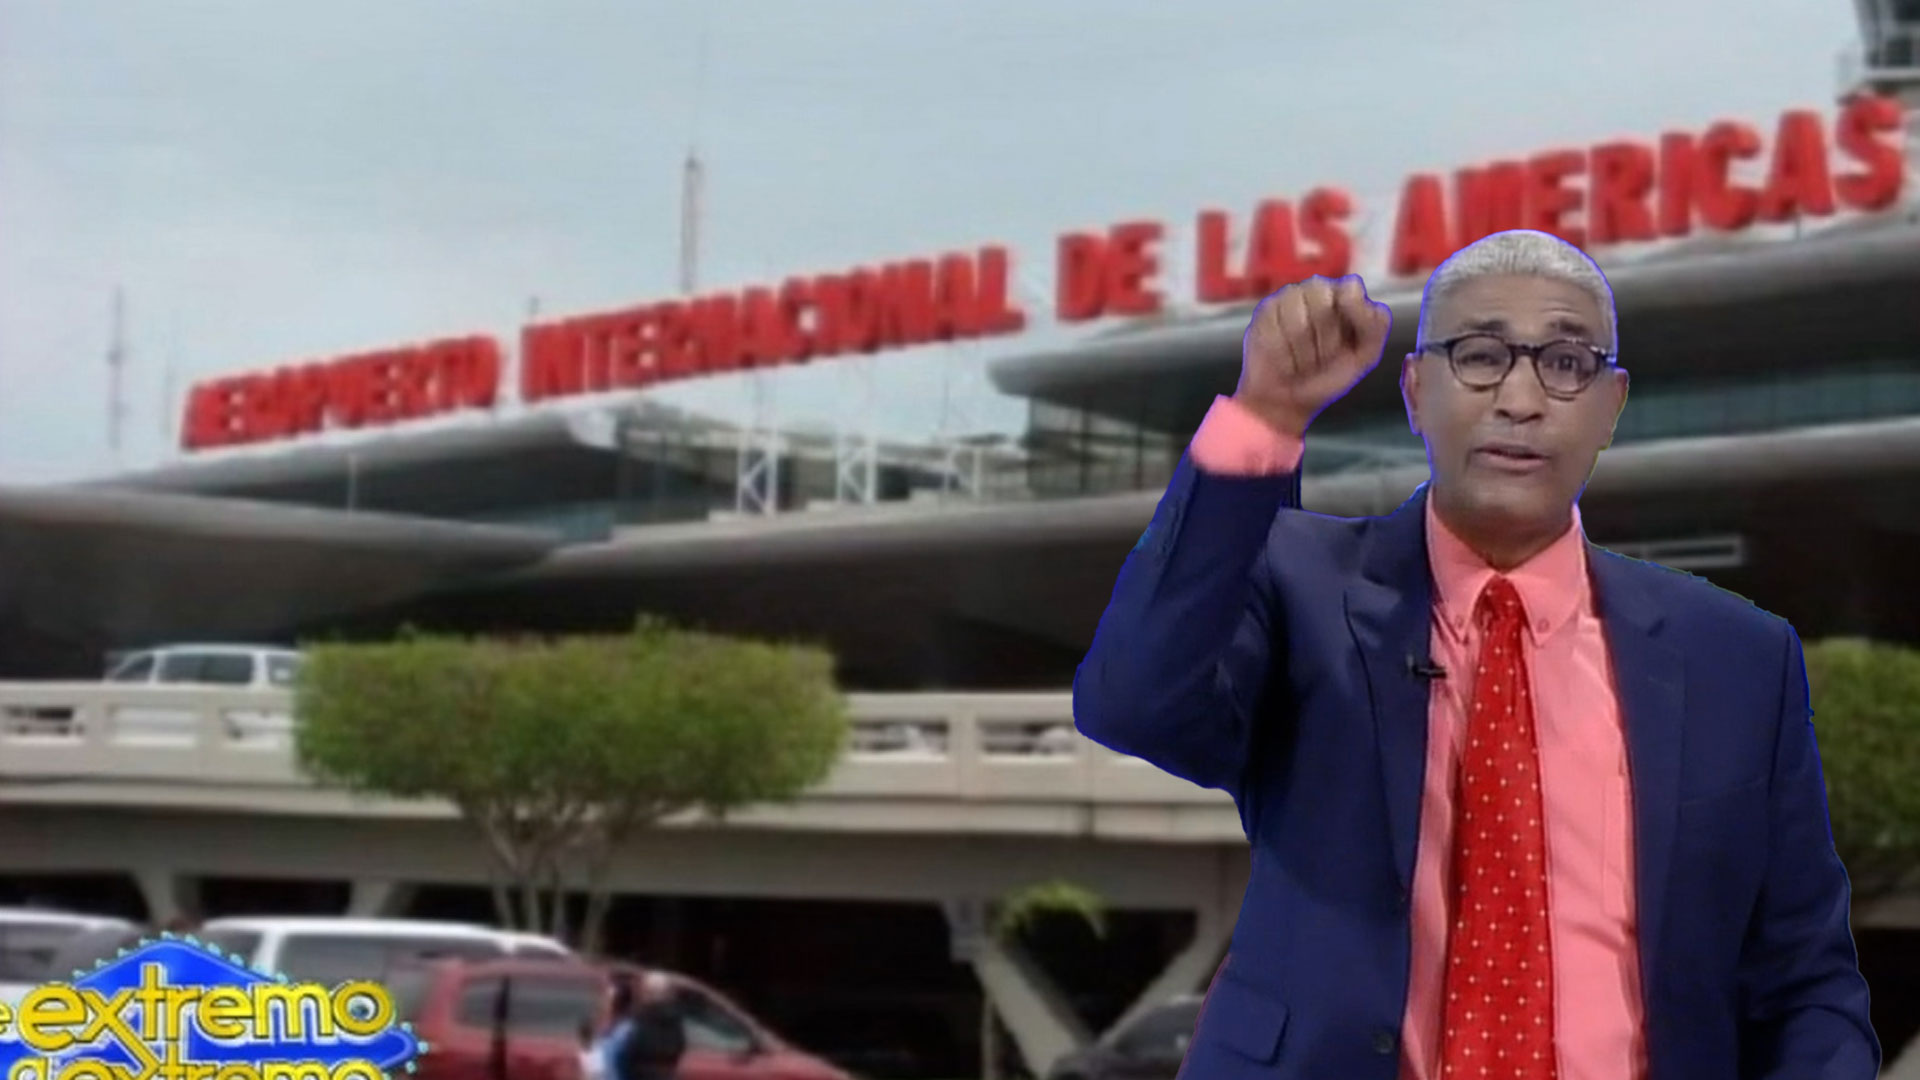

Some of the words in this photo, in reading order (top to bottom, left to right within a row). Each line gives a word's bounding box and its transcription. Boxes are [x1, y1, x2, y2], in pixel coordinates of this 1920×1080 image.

[181, 335, 500, 450] AEROPUERTO
[521, 246, 1025, 401] INTERNACIONAL
[1056, 221, 1163, 322] DE
[1196, 187, 1353, 304] LAS
[1389, 92, 1906, 276] AMERICAS
